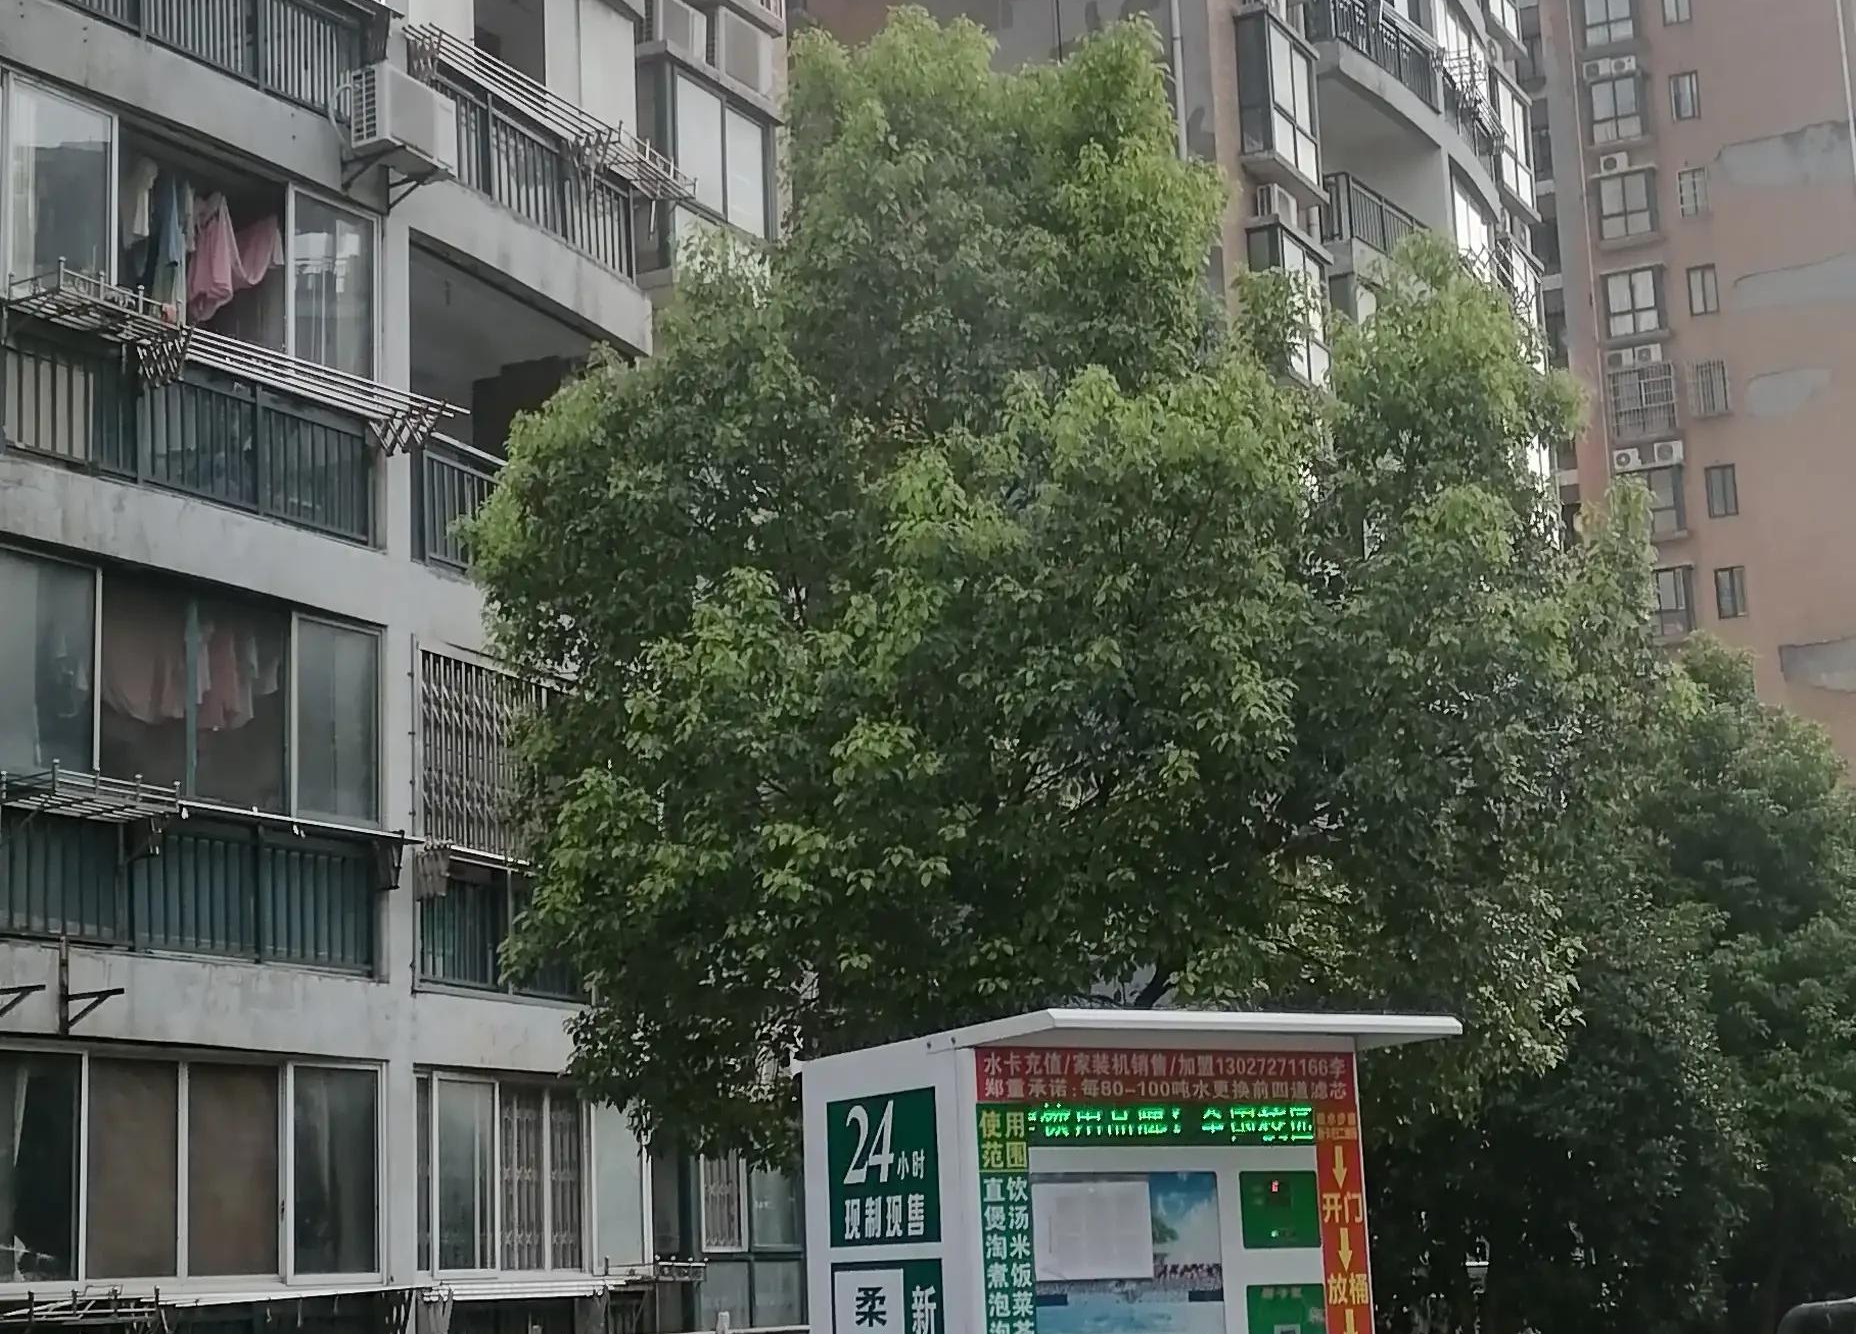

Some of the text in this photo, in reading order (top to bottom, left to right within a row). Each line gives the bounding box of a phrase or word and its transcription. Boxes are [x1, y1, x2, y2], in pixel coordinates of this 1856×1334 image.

[979, 1110, 1025, 1139] 使用
[981, 1140, 1028, 1168] 范围
[983, 1176, 1029, 1203] 直饮
[844, 1193, 925, 1240] 现制现售
[984, 1205, 1030, 1231] 煲汤
[1322, 1192, 1363, 1223] 开门
[985, 1234, 1031, 1260] 淘米
[987, 1263, 1033, 1288] 煮饭
[1328, 1272, 1370, 1304] 放桶
[988, 1290, 1034, 1317] 泡菜
